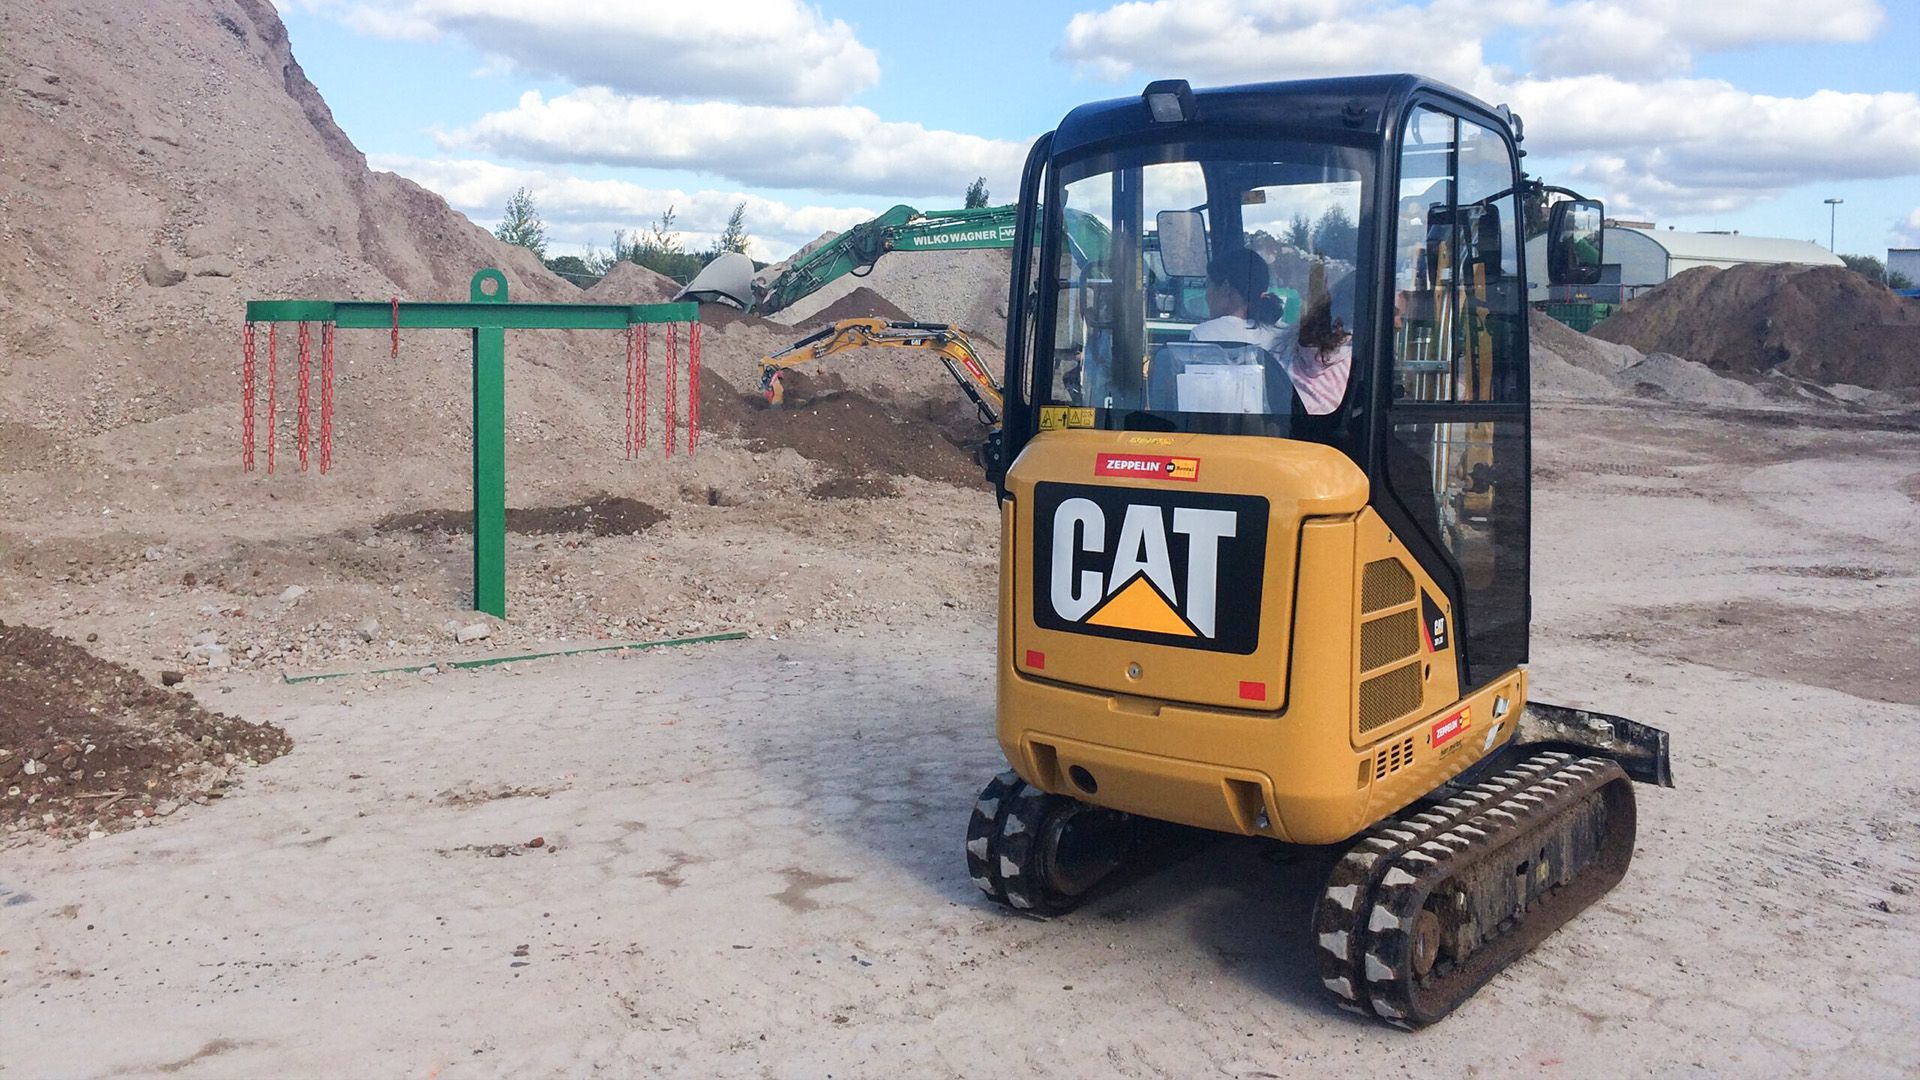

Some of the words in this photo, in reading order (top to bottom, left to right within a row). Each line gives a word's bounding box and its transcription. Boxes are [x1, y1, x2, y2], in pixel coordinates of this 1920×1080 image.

[913, 234, 949, 246] WILKO
[950, 229, 997, 243] WAGNER
[1106, 459, 1160, 472] ZEPPELIN
[1051, 497, 1237, 639] CAT
[1434, 617, 1444, 636] CAT
[1436, 719, 1457, 739] ZEPPELIN
